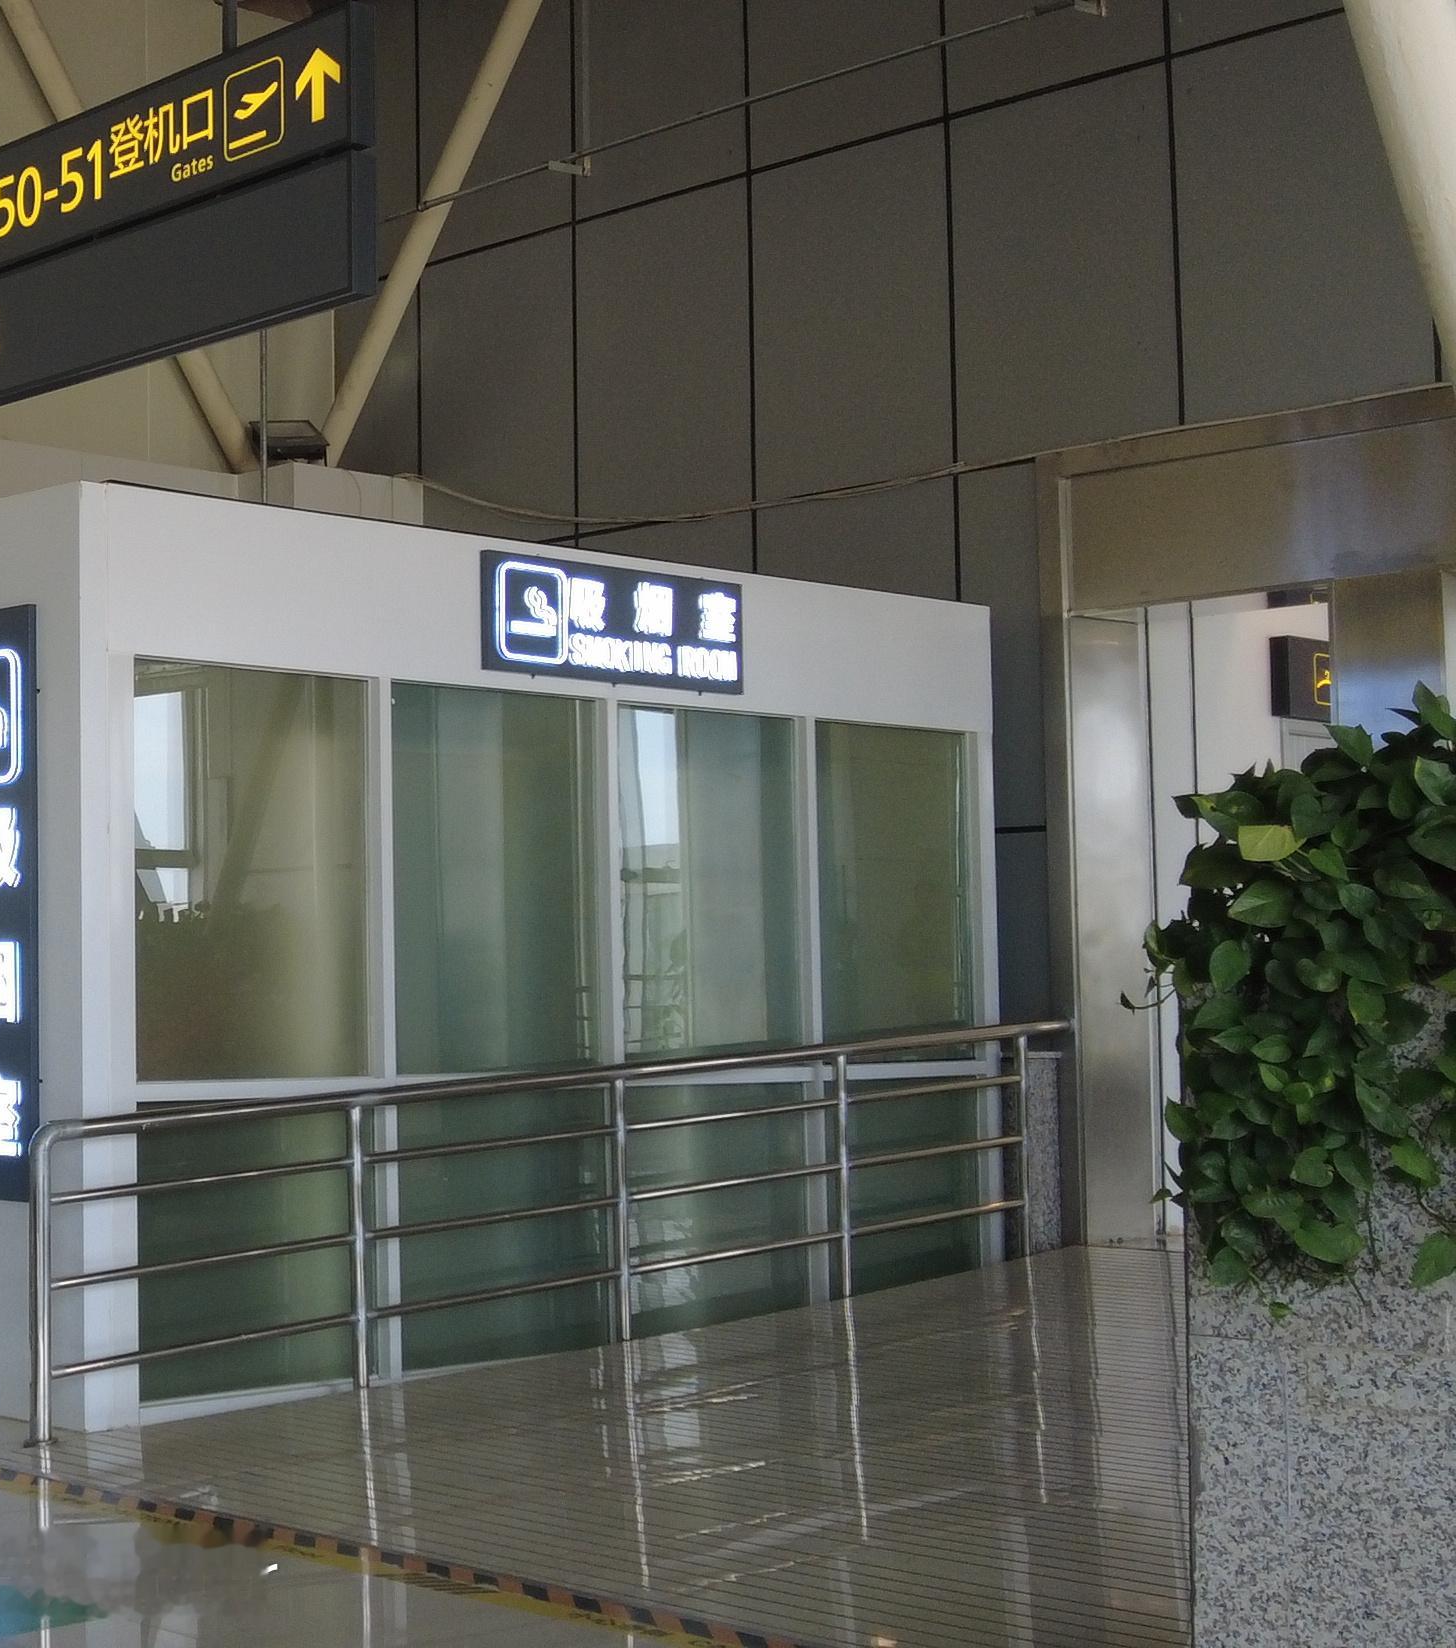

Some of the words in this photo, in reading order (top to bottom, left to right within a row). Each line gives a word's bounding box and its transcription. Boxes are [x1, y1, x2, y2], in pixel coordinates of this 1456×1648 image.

[170, 153, 214, 183] Gates
[568, 576, 738, 643] 吸烟室
[568, 633, 673, 676] SMOKING
[677, 645, 739, 682] ROOM
